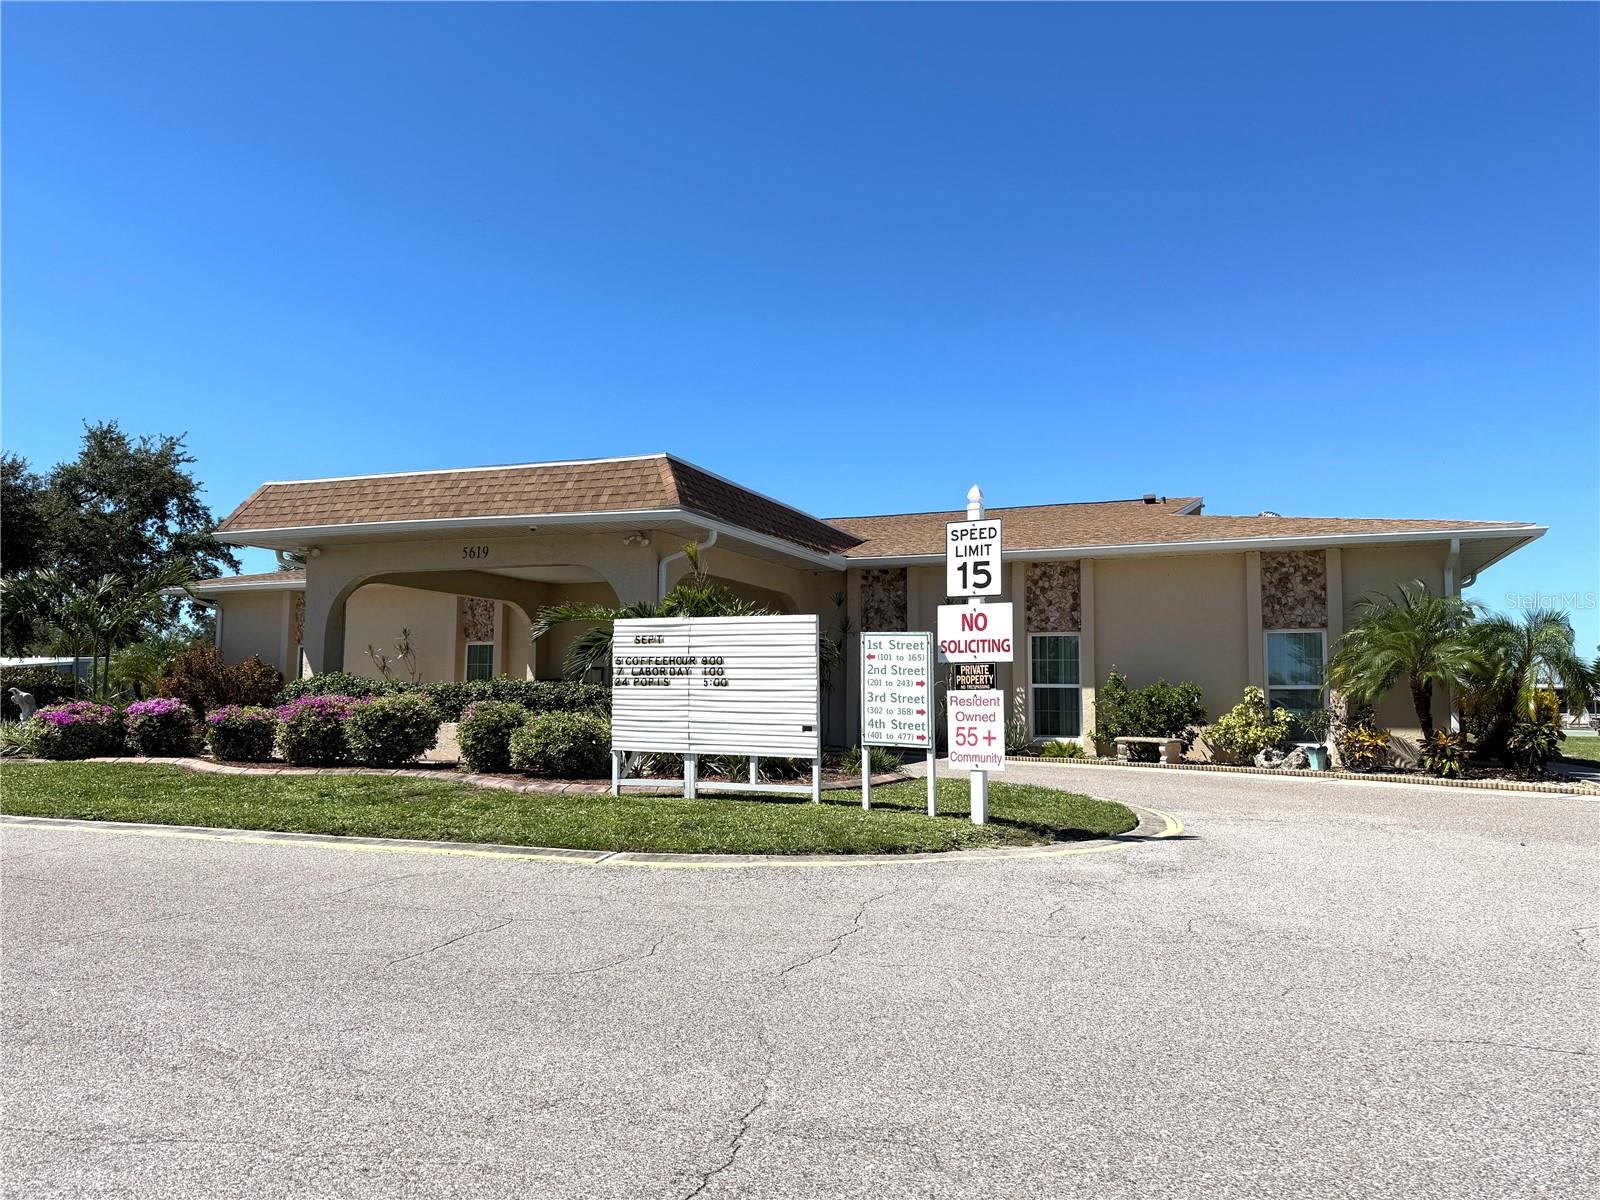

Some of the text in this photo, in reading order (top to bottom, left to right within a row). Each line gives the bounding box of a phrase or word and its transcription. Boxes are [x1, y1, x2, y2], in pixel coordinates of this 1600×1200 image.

[951, 527, 997, 541] SPEED
[462, 545, 489, 559] 5619
[955, 544, 992, 557] LIMIT
[957, 561, 992, 589] 15
[961, 613, 988, 631] NO
[634, 635, 663, 644] SEPT
[867, 640, 925, 650] 1st Street
[940, 639, 1011, 653] SOLICITING
[877, 653, 892, 661] (101
[867, 665, 926, 675] 2nd Street
[960, 665, 990, 675] PRIVATE
[614, 678, 628, 687] 24
[703, 678, 728, 687] 5:00
[867, 679, 882, 687] (201
[956, 675, 994, 685] PROPERTY
[867, 692, 925, 704] 3rd Street
[950, 696, 1000, 707] Resident
[867, 707, 883, 715] (302
[897, 708, 914, 716] 368)
[955, 711, 996, 723] Owned
[867, 719, 926, 731] 4th Street
[897, 733, 914, 741] 477)
[950, 751, 1003, 766] Community
